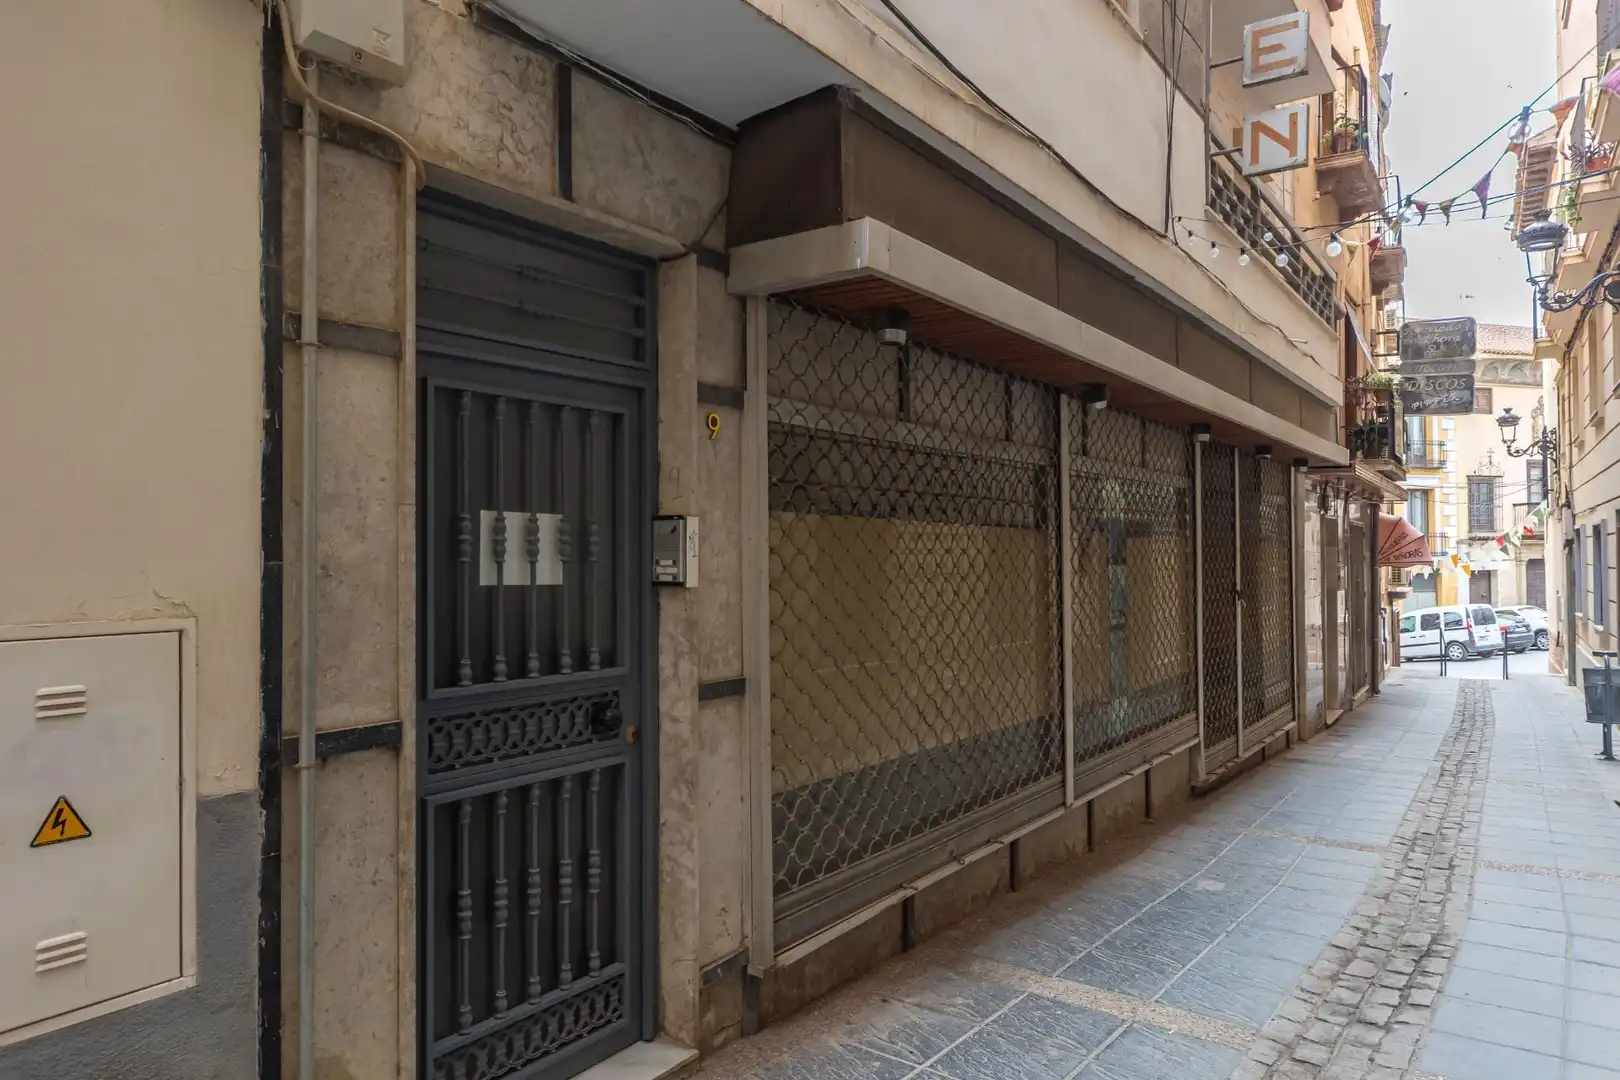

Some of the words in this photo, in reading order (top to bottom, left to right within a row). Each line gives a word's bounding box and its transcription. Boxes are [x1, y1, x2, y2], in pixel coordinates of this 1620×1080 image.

[1252, 20, 1299, 73] E
[1251, 112, 1298, 165] N
[1405, 379, 1466, 392] DISCOS
[707, 412, 720, 440] 9
